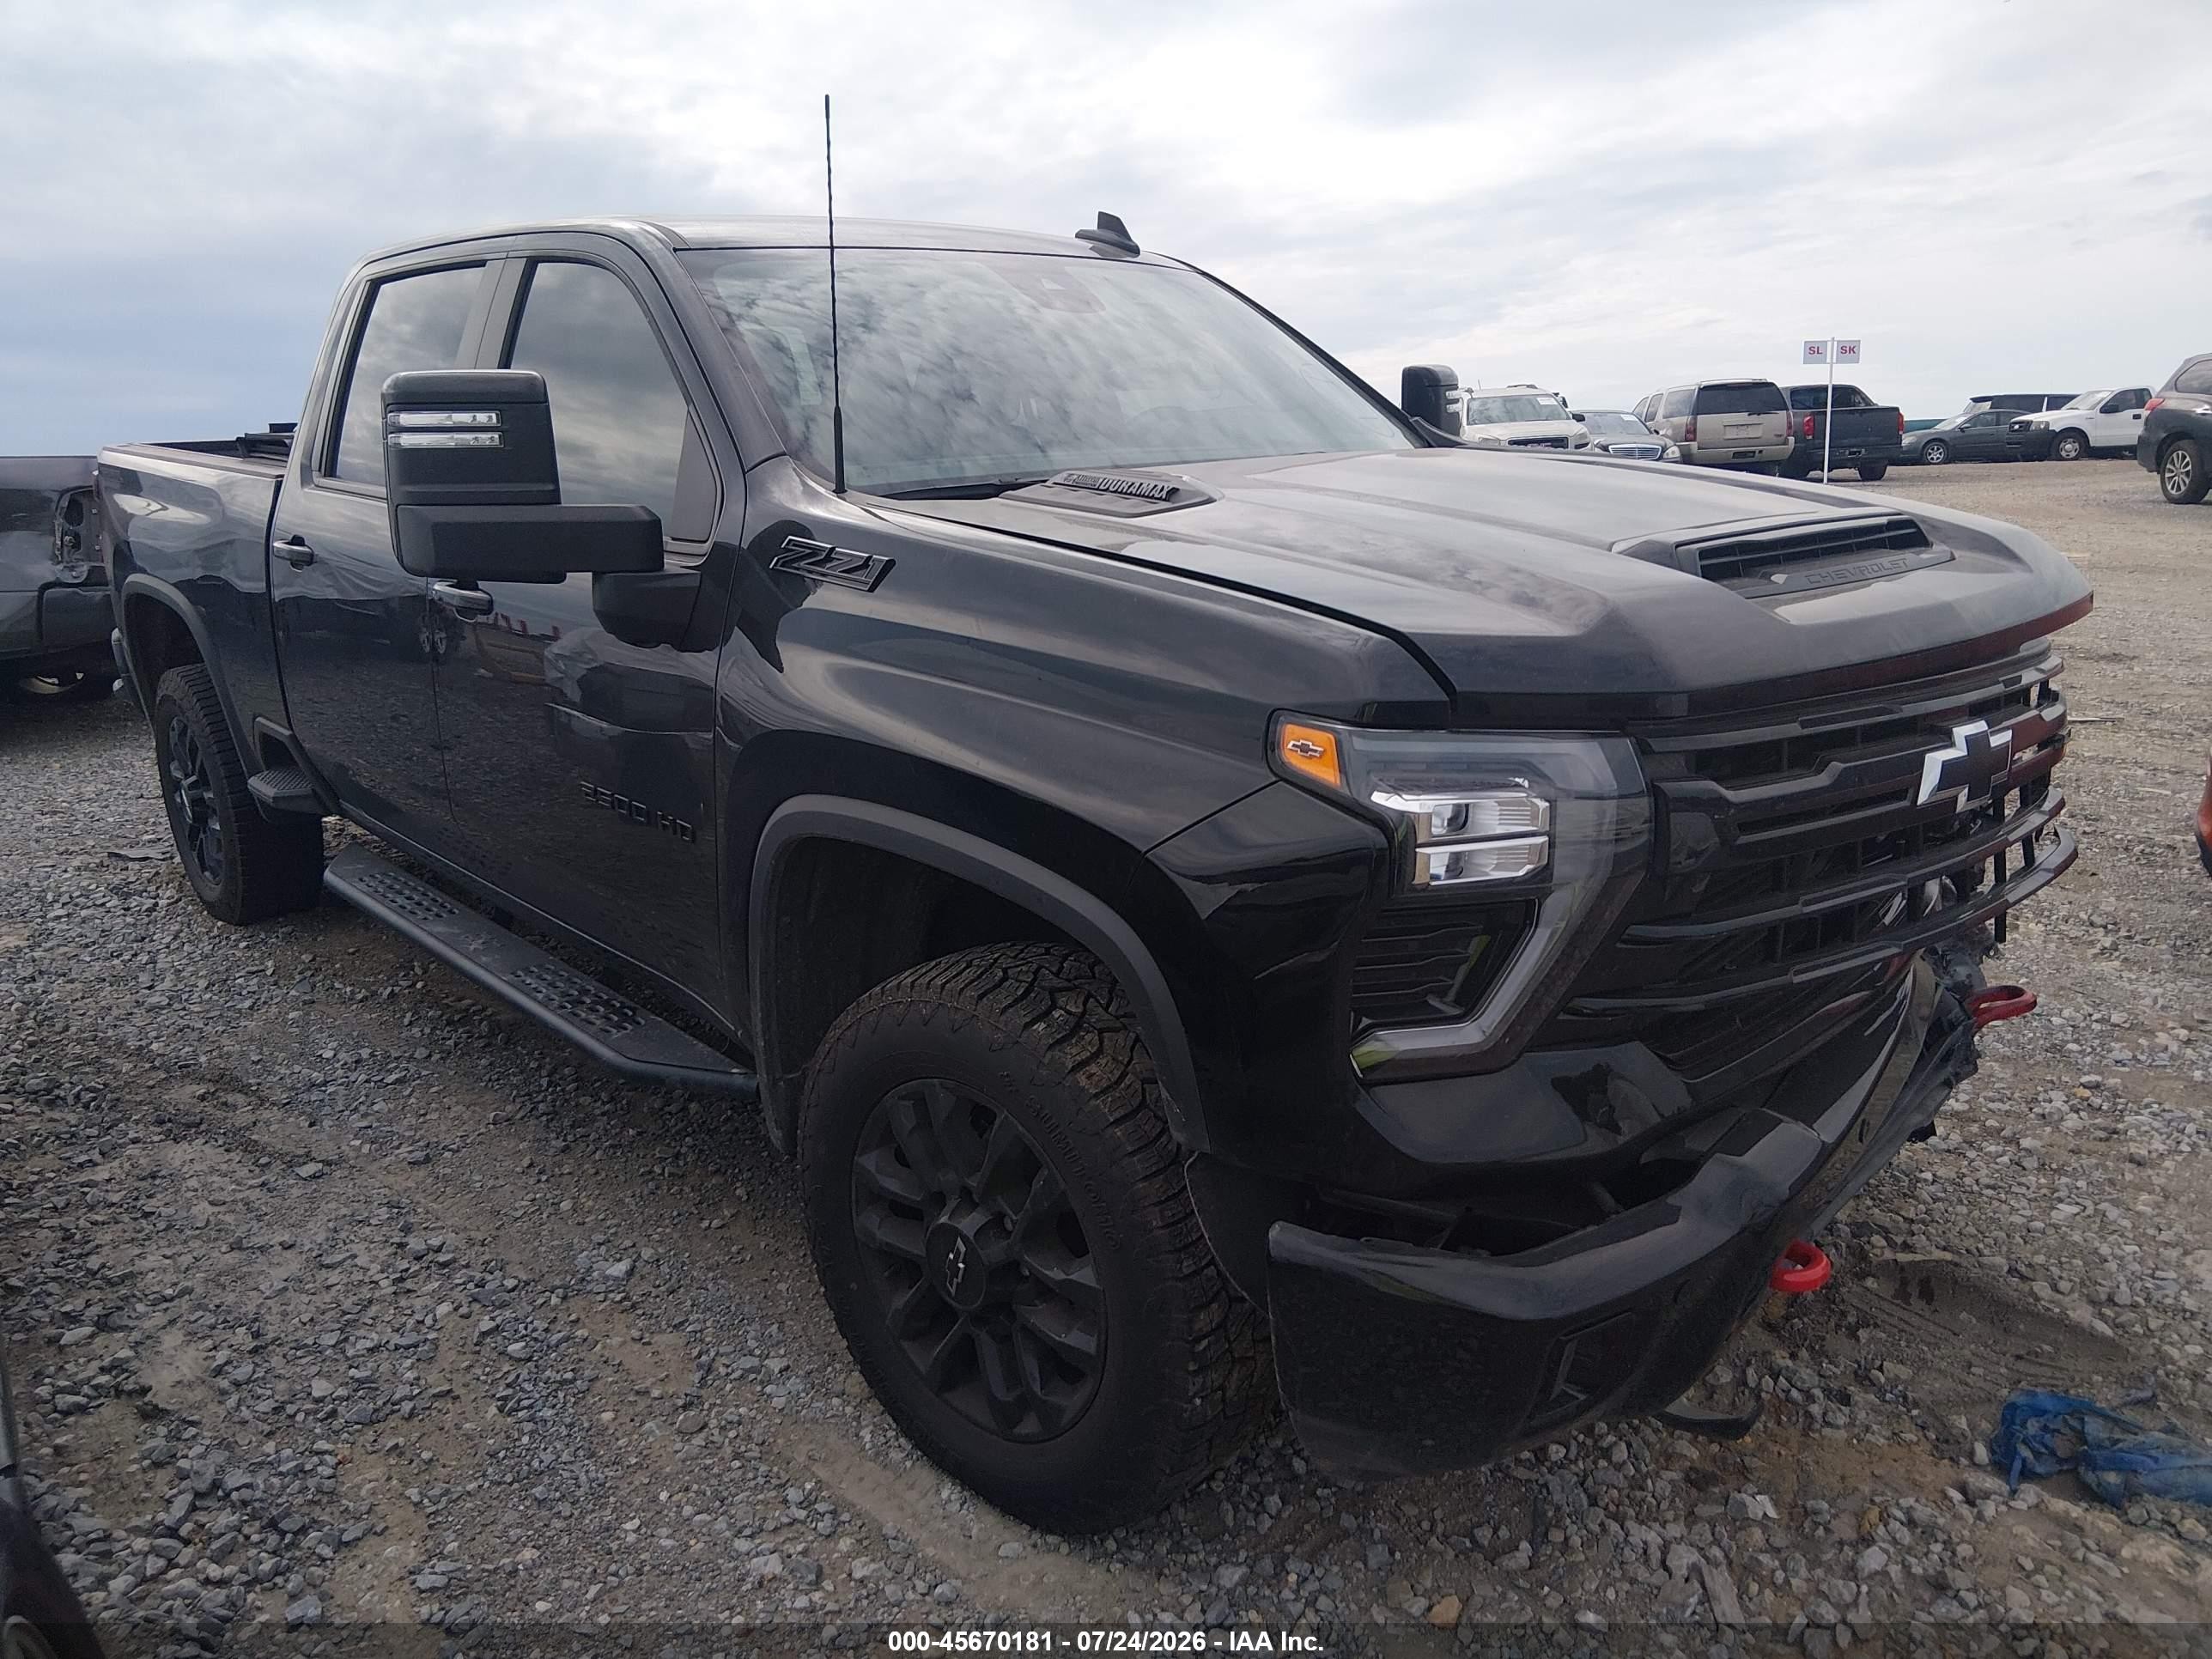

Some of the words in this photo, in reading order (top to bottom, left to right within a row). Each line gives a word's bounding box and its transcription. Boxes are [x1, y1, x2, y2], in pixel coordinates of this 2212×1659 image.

[1808, 345, 1823, 355] SL
[1840, 345, 1856, 355] SK
[1099, 477, 1174, 500] DURAMAX
[769, 535, 896, 592] Z71
[1805, 557, 1911, 585] CHEVROLET
[655, 809, 696, 844] HD
